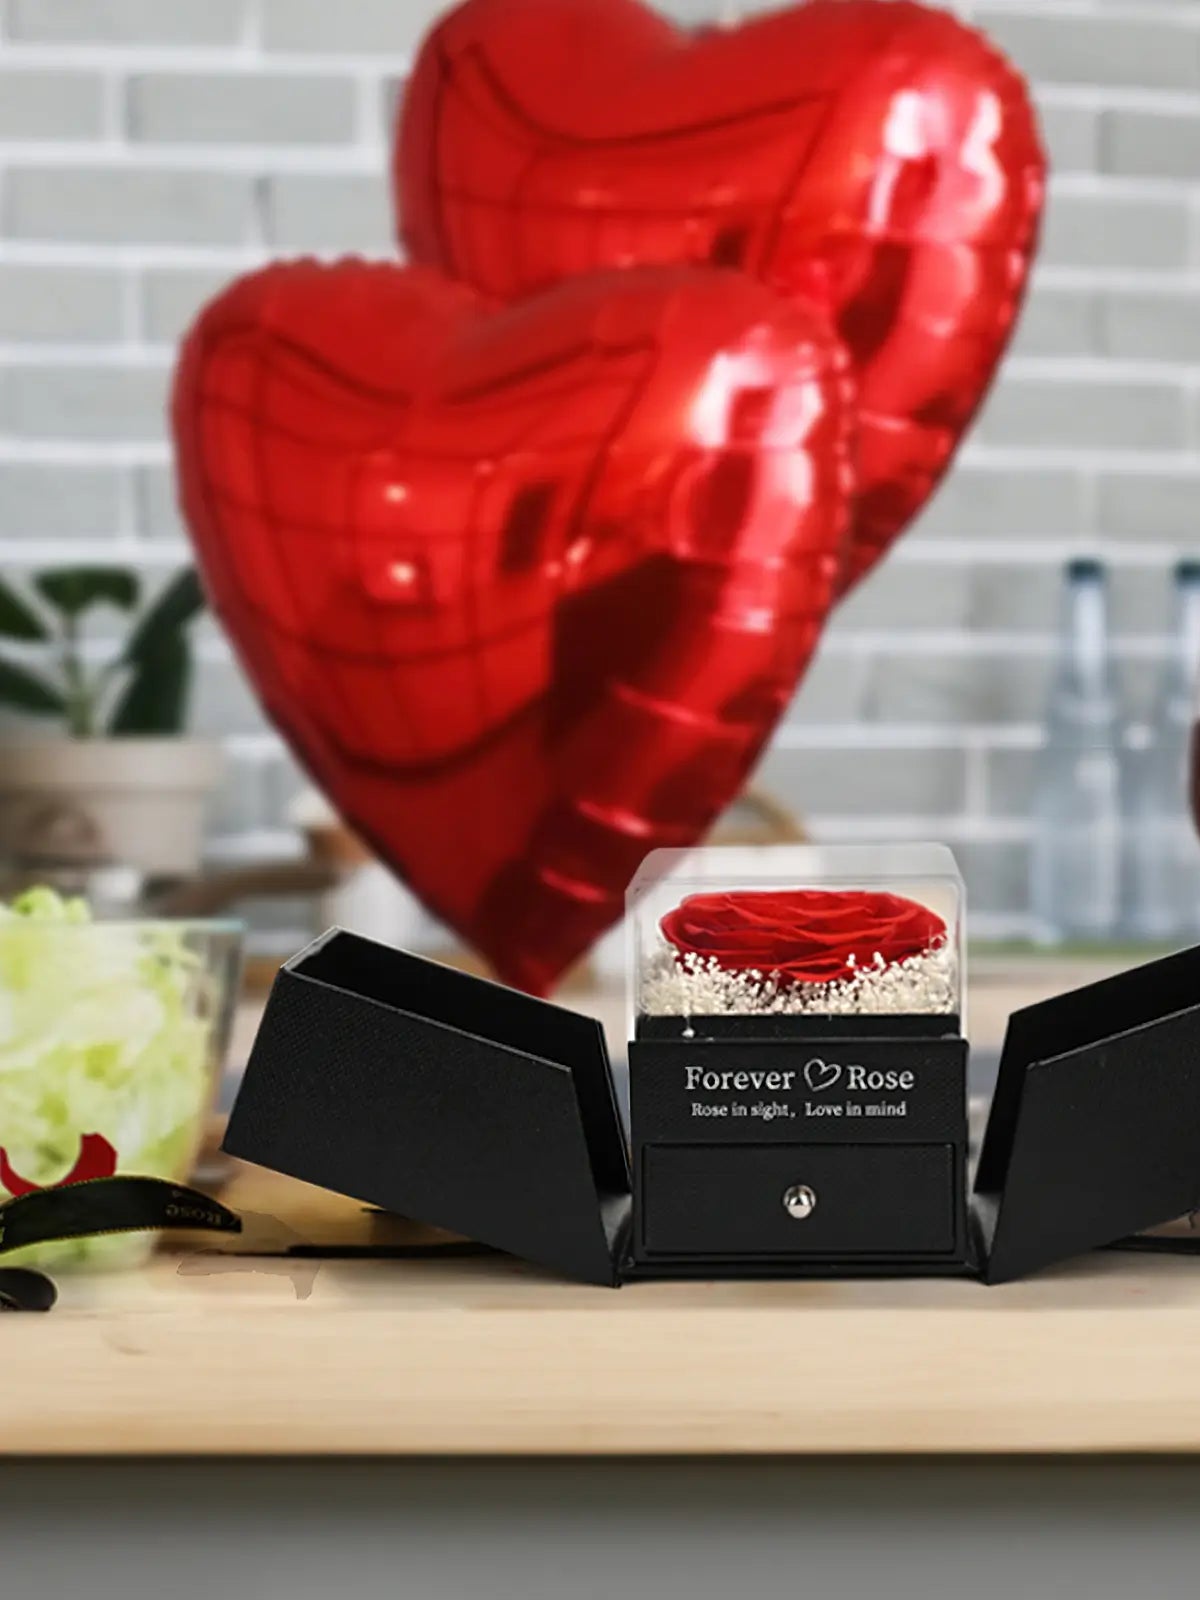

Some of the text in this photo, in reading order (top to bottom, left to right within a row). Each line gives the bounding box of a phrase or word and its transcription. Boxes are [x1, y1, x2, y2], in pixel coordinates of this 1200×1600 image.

[684, 1065, 915, 1090] Forever Rose
[691, 1100, 907, 1121] Rose in sight, Love in mind
